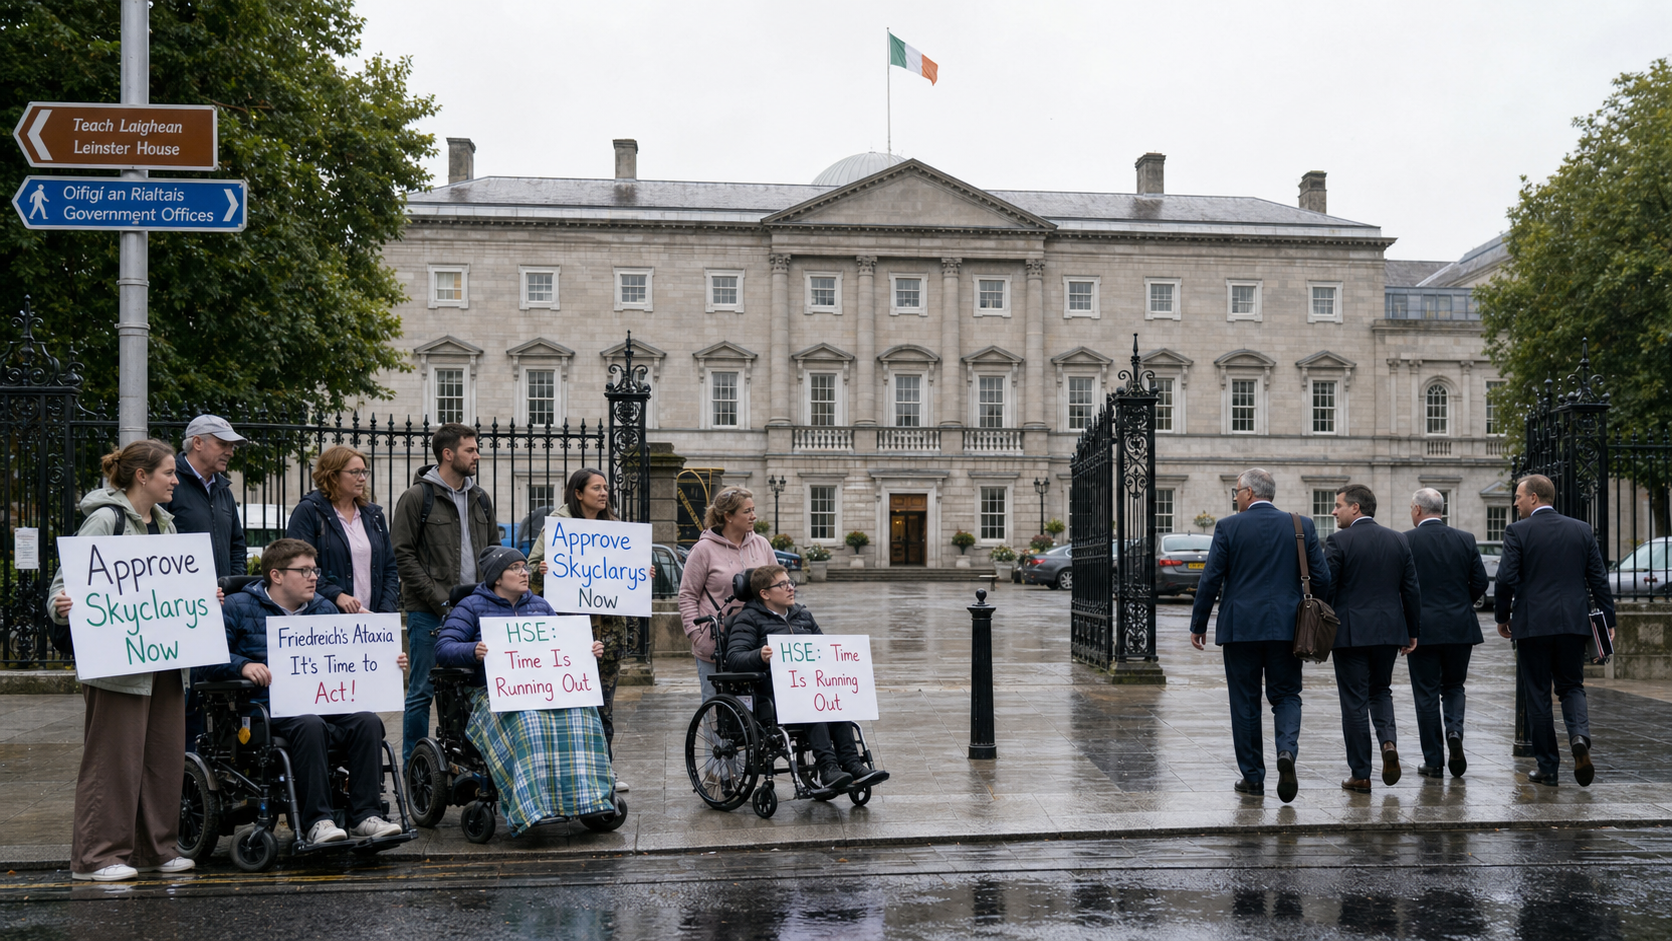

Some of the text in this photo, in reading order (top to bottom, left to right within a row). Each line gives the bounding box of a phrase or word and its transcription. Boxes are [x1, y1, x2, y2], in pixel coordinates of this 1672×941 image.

[73, 117, 183, 136] Teach Laighean
[73, 140, 180, 156] Leinster House
[63, 185, 184, 203] Oifigí an Rialtais
[63, 205, 214, 222] Government Offices
[552, 521, 632, 556] Approve
[87, 544, 200, 595] Approve
[552, 552, 647, 591] Skyclarys
[578, 587, 618, 609] Now
[86, 589, 209, 636] Skyclarys
[278, 623, 394, 648] Friedreich's Ataxia
[505, 621, 557, 644] HSE:
[125, 635, 179, 665] Now
[504, 648, 572, 670] Time Is
[780, 642, 860, 663] HSE: Time
[290, 653, 378, 676] It's Time to
[314, 679, 356, 705] Act!
[495, 672, 592, 702] Running Out
[789, 669, 859, 694] Is Running
[813, 692, 843, 712] Out
